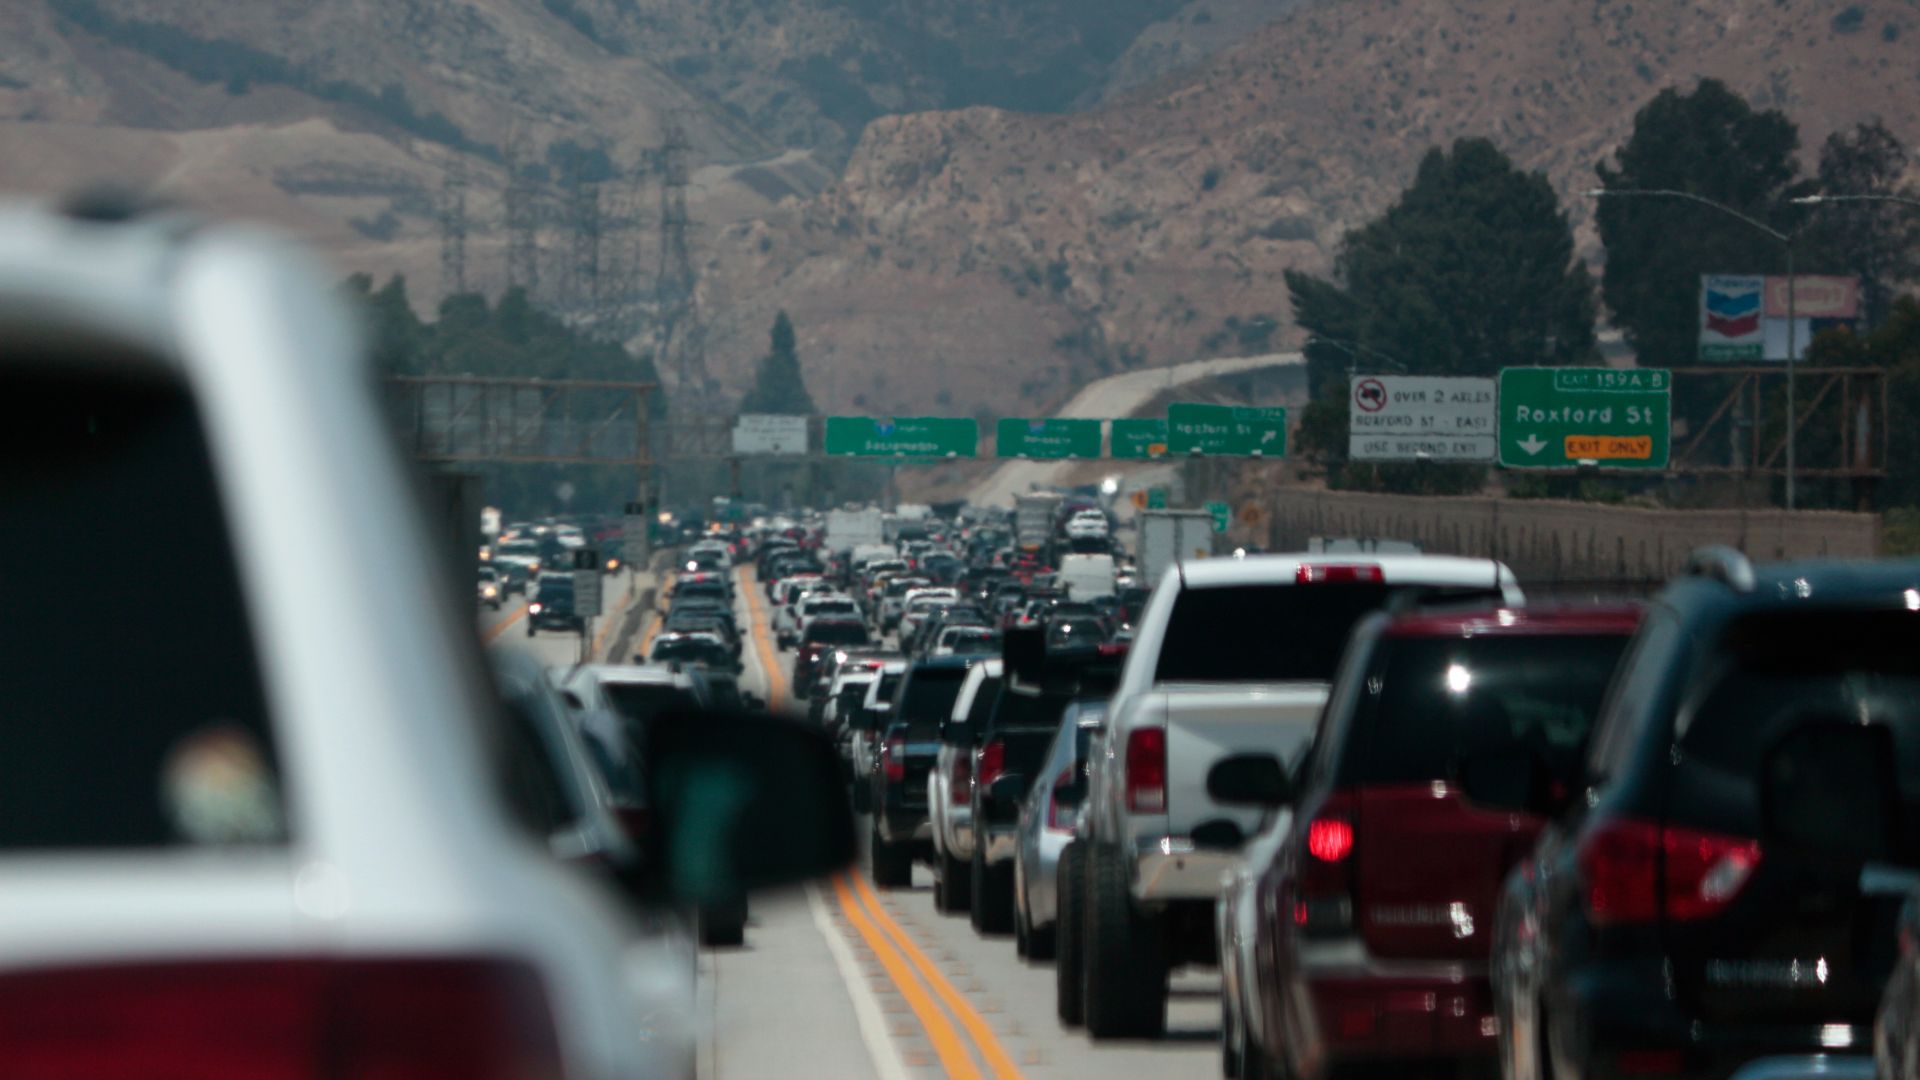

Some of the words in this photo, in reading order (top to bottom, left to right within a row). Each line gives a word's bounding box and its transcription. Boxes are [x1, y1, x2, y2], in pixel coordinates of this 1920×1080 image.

[1394, 391, 1426, 403] OVER
[1434, 390, 1444, 403] 2
[1451, 391, 1491, 403] AXLES
[1516, 405, 1613, 424] Roxford
[1626, 406, 1653, 424] St
[1355, 415, 1413, 427] ROXFORD
[1420, 415, 1434, 427] ST
[1456, 416, 1487, 428] EAST
[1363, 441, 1389, 453] USE
[1453, 442, 1477, 454] EXIT
[1567, 441, 1601, 453] EXIT
[1608, 440, 1648, 454] ONLY
